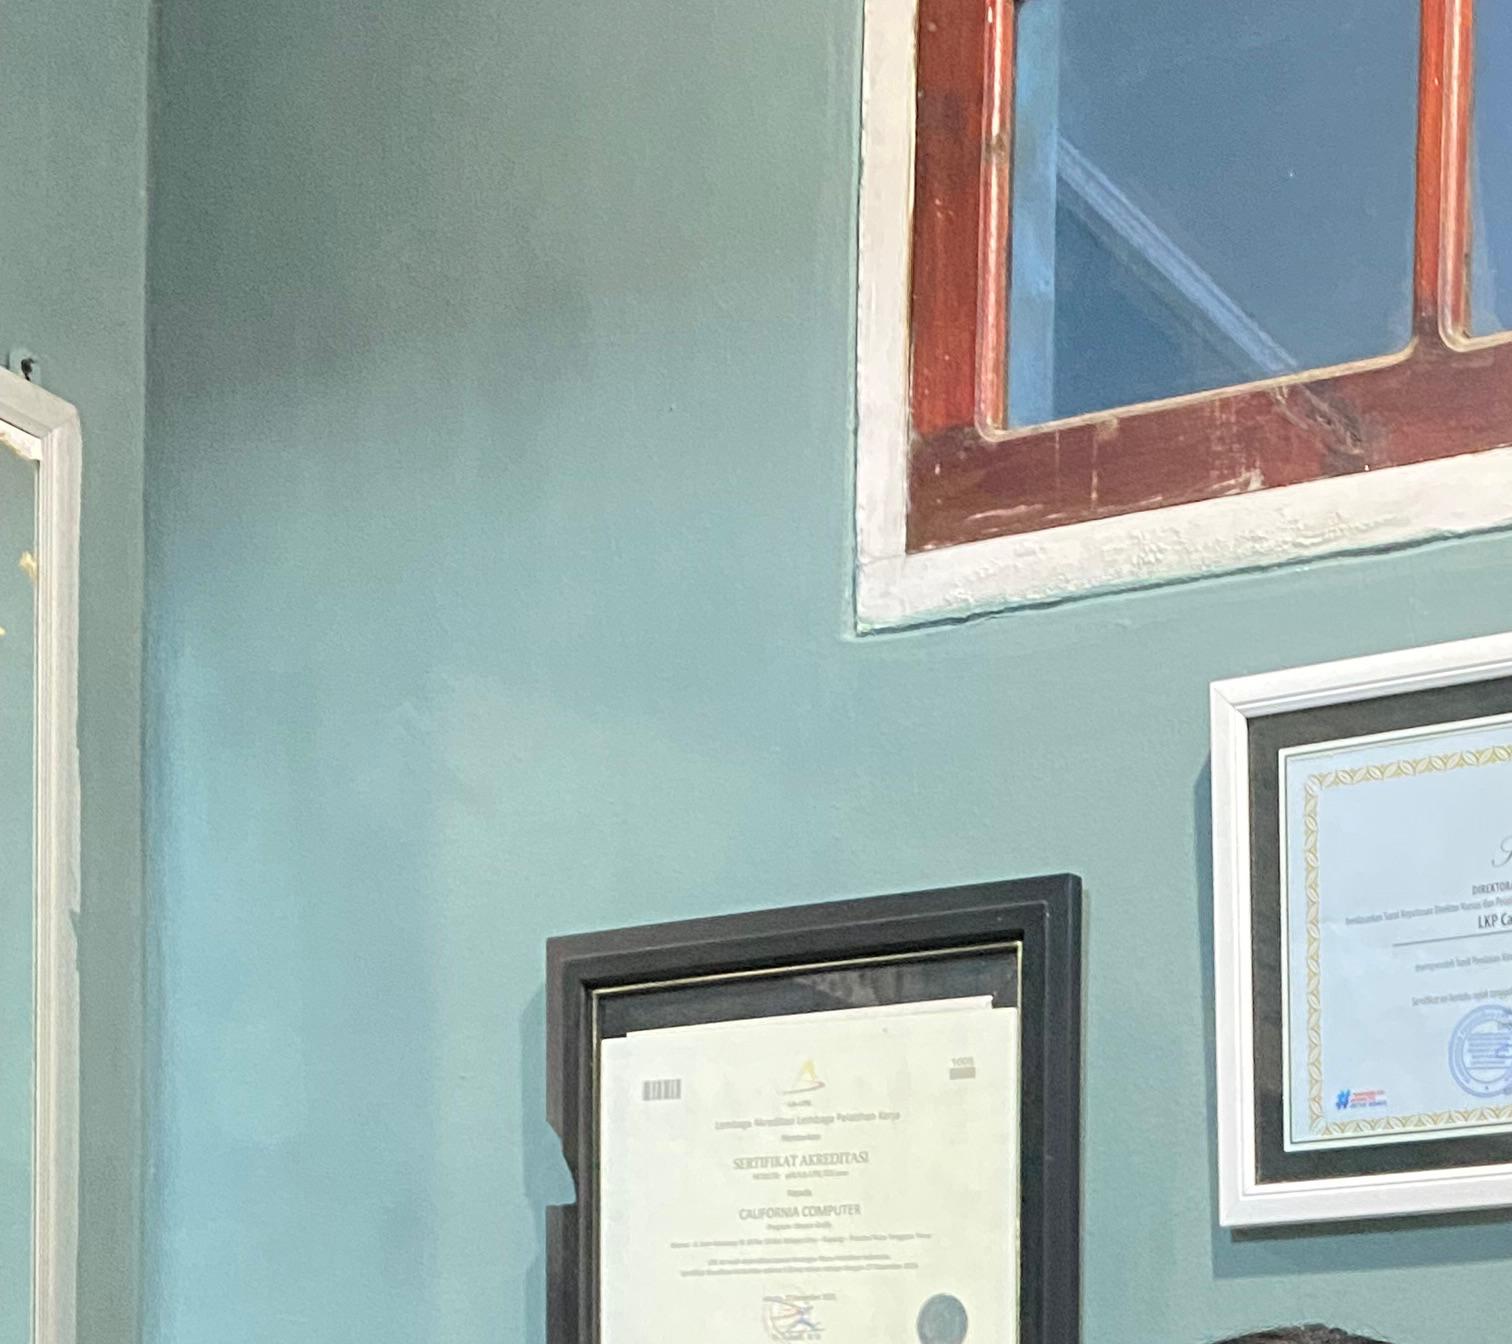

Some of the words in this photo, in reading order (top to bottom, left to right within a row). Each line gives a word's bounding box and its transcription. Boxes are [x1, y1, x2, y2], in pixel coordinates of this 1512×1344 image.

[1478, 913, 1497, 929] LKP
[733, 1155, 799, 1170] SERTIFIKAT
[799, 1151, 870, 1166] AKREDITASI
[739, 1206, 800, 1220] CALIFORNIA
[801, 1204, 862, 1218] COMPUTER
